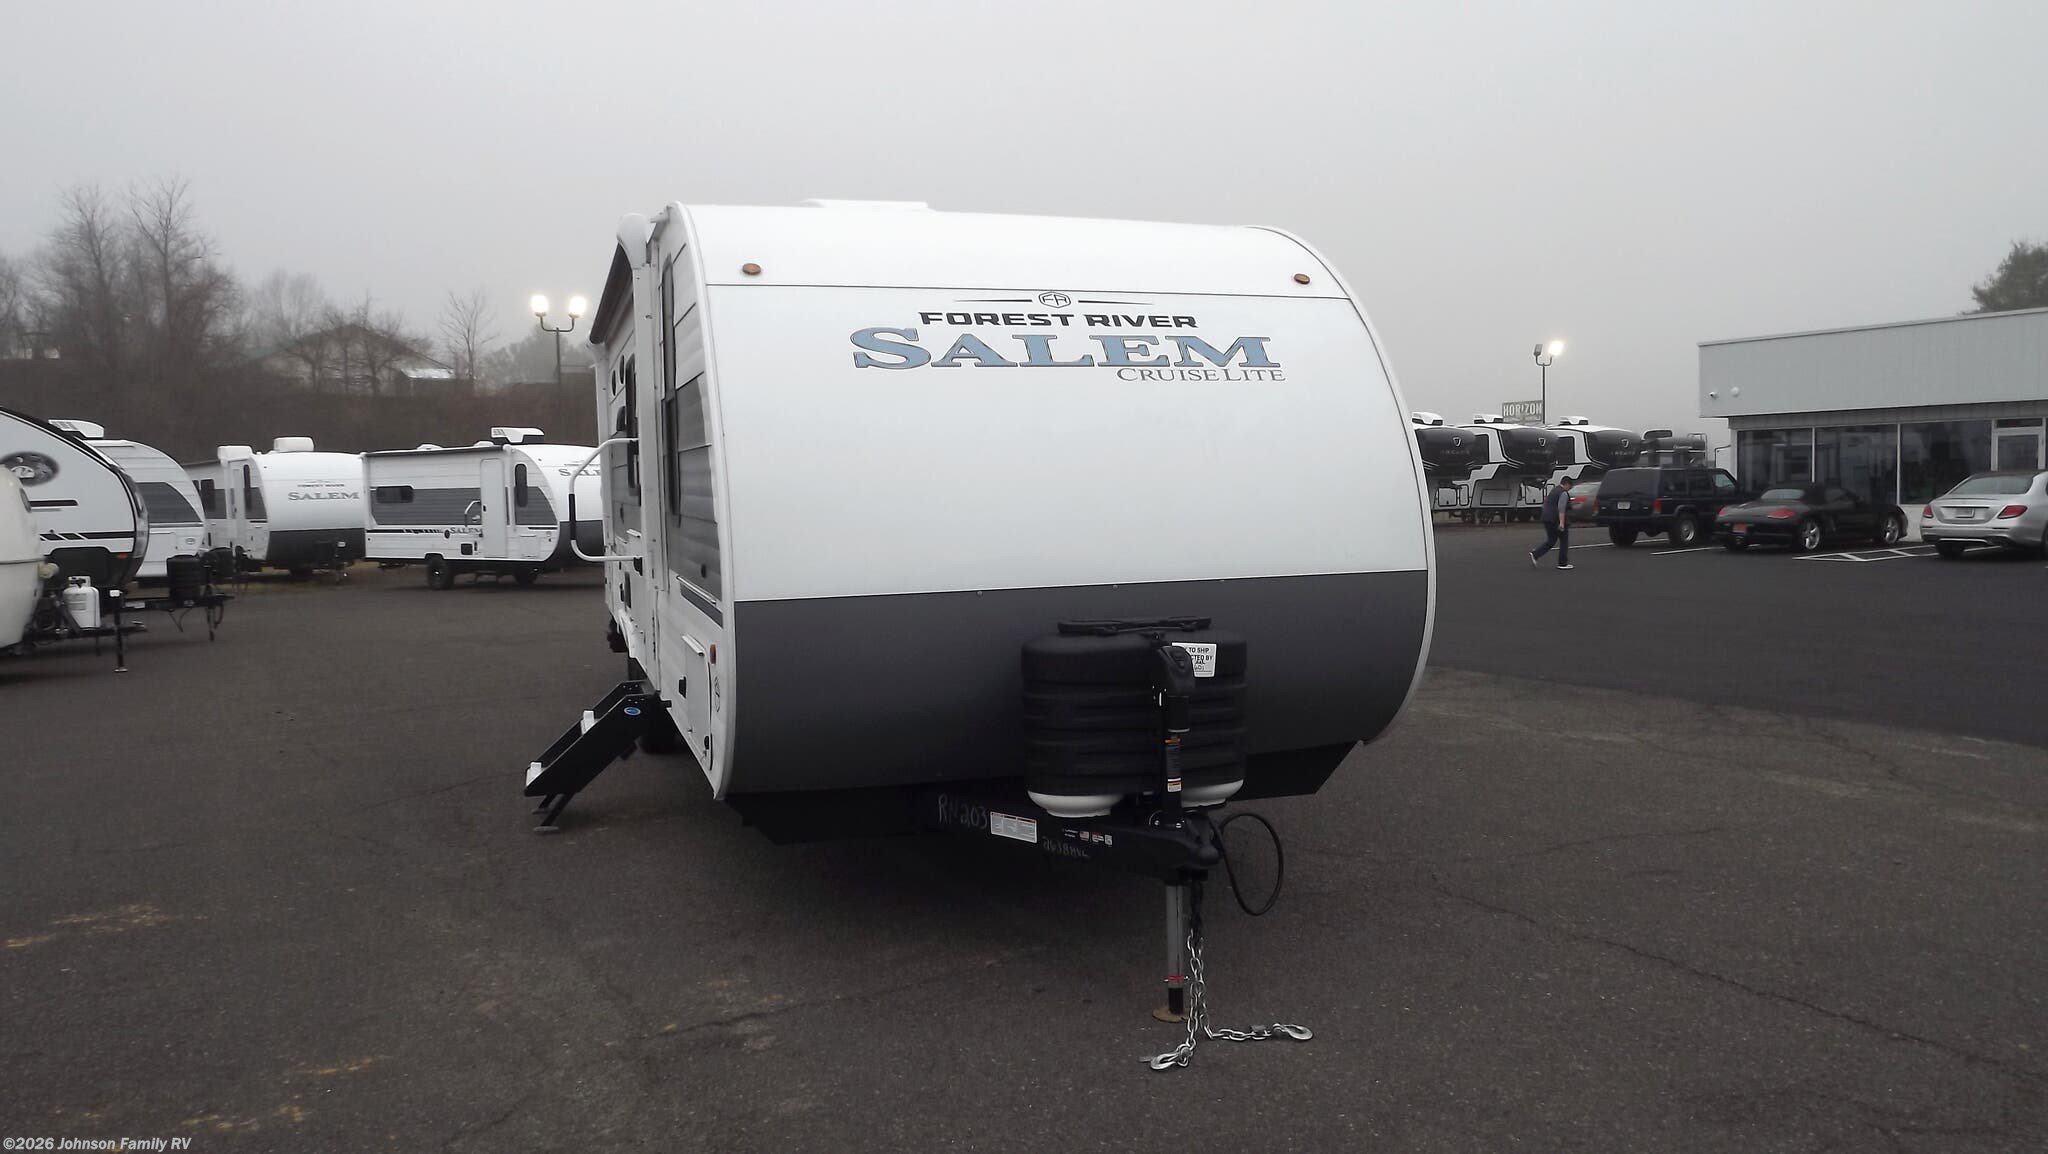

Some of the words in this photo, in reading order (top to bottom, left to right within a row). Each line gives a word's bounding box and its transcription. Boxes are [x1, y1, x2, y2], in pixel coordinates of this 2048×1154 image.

[918, 311, 1074, 327] FOREST
[1083, 314, 1198, 329] RIVER
[850, 327, 1282, 370] SALEM
[1503, 403, 1542, 417] HORIZON
[288, 491, 360, 501] SALEM
